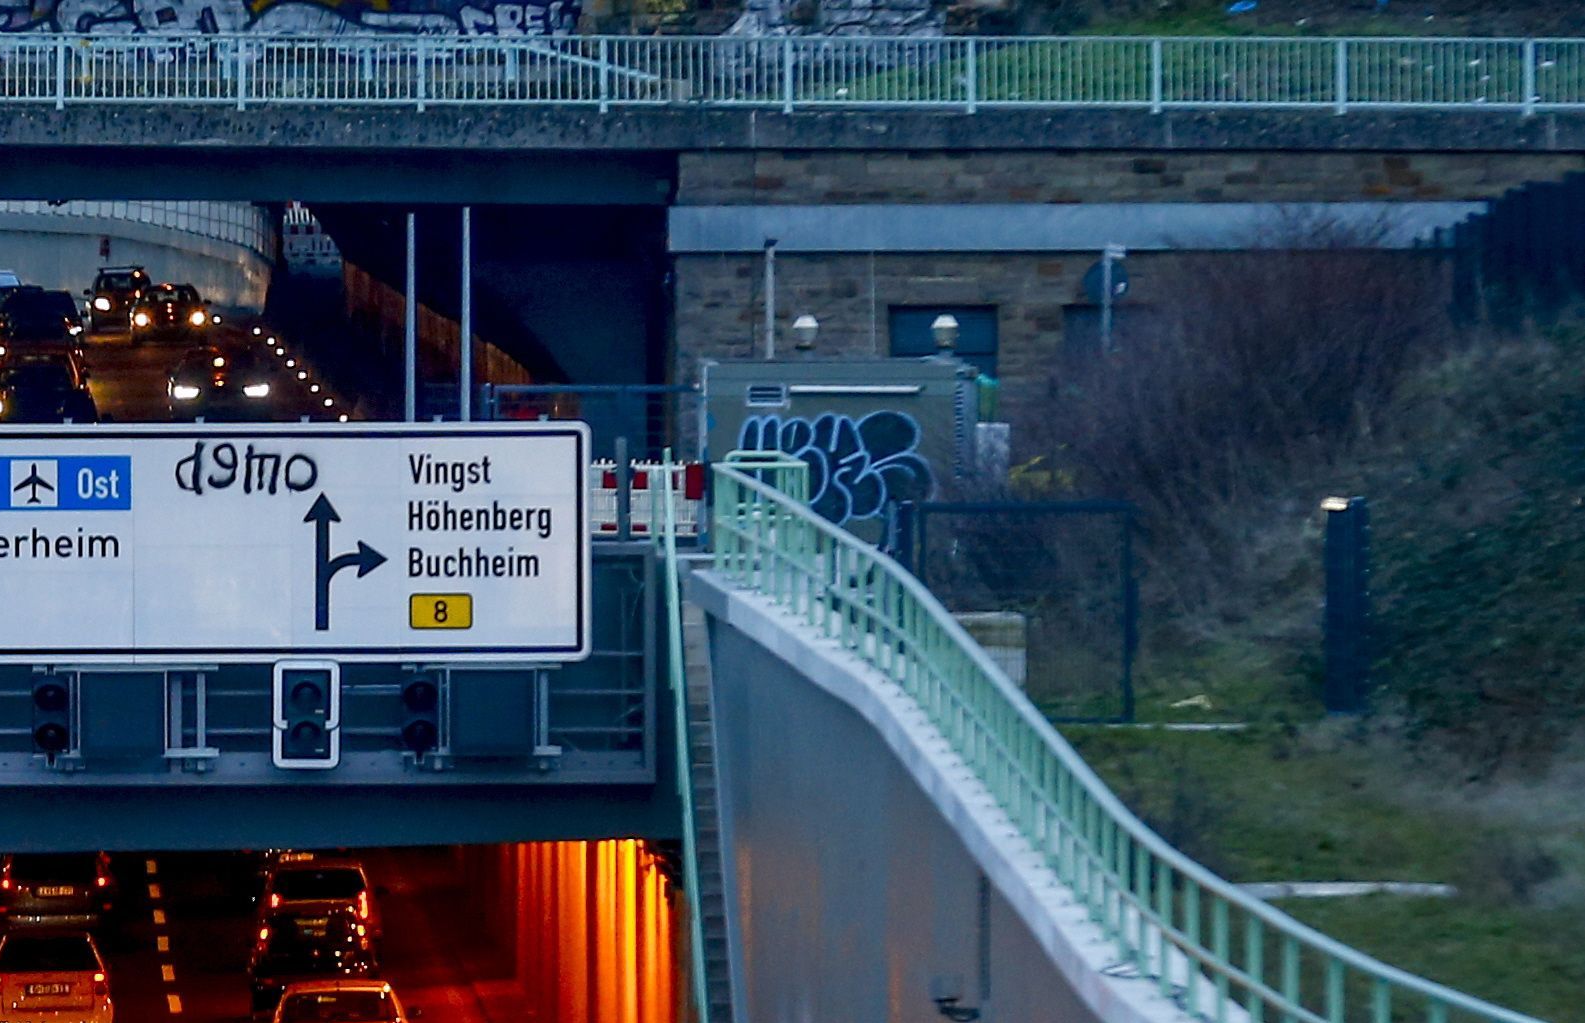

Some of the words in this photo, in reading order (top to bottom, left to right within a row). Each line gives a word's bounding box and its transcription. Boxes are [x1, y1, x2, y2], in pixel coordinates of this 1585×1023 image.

[77, 468, 119, 499] Ost
[408, 453, 492, 492] Vingst
[408, 500, 552, 538] Höhenberg
[408, 548, 540, 578] Buchheim
[433, 600, 448, 622] 8
